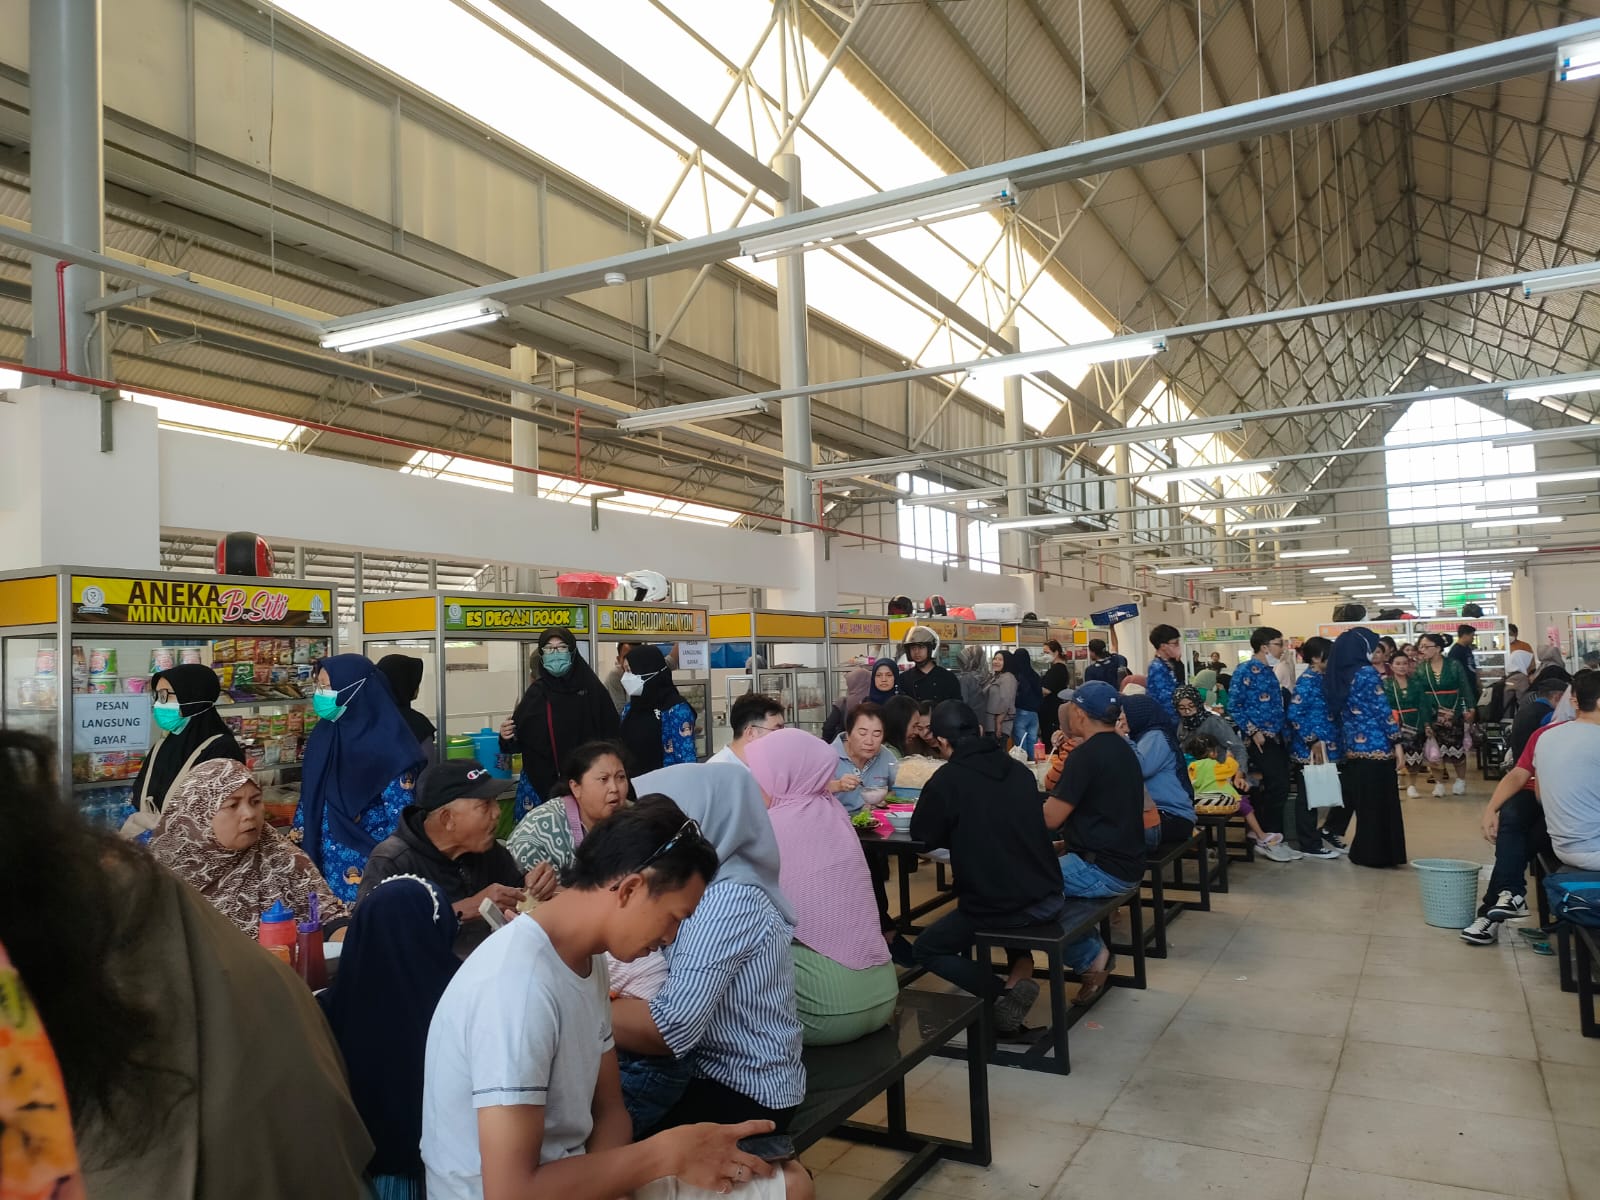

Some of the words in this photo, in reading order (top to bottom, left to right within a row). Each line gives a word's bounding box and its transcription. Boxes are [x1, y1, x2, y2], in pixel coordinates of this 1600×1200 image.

[128, 581, 223, 607] ANEKA
[127, 605, 224, 624] MINUMAN
[466, 611, 482, 627] ES
[485, 608, 531, 626] DEGAN
[533, 609, 570, 625] POJOK
[613, 610, 639, 630] BAKSO
[640, 611, 664, 631] POJOK
[96, 701, 129, 711] PESAN
[82, 717, 141, 728] LANGSUNG
[94, 735, 127, 745] BAYAR
